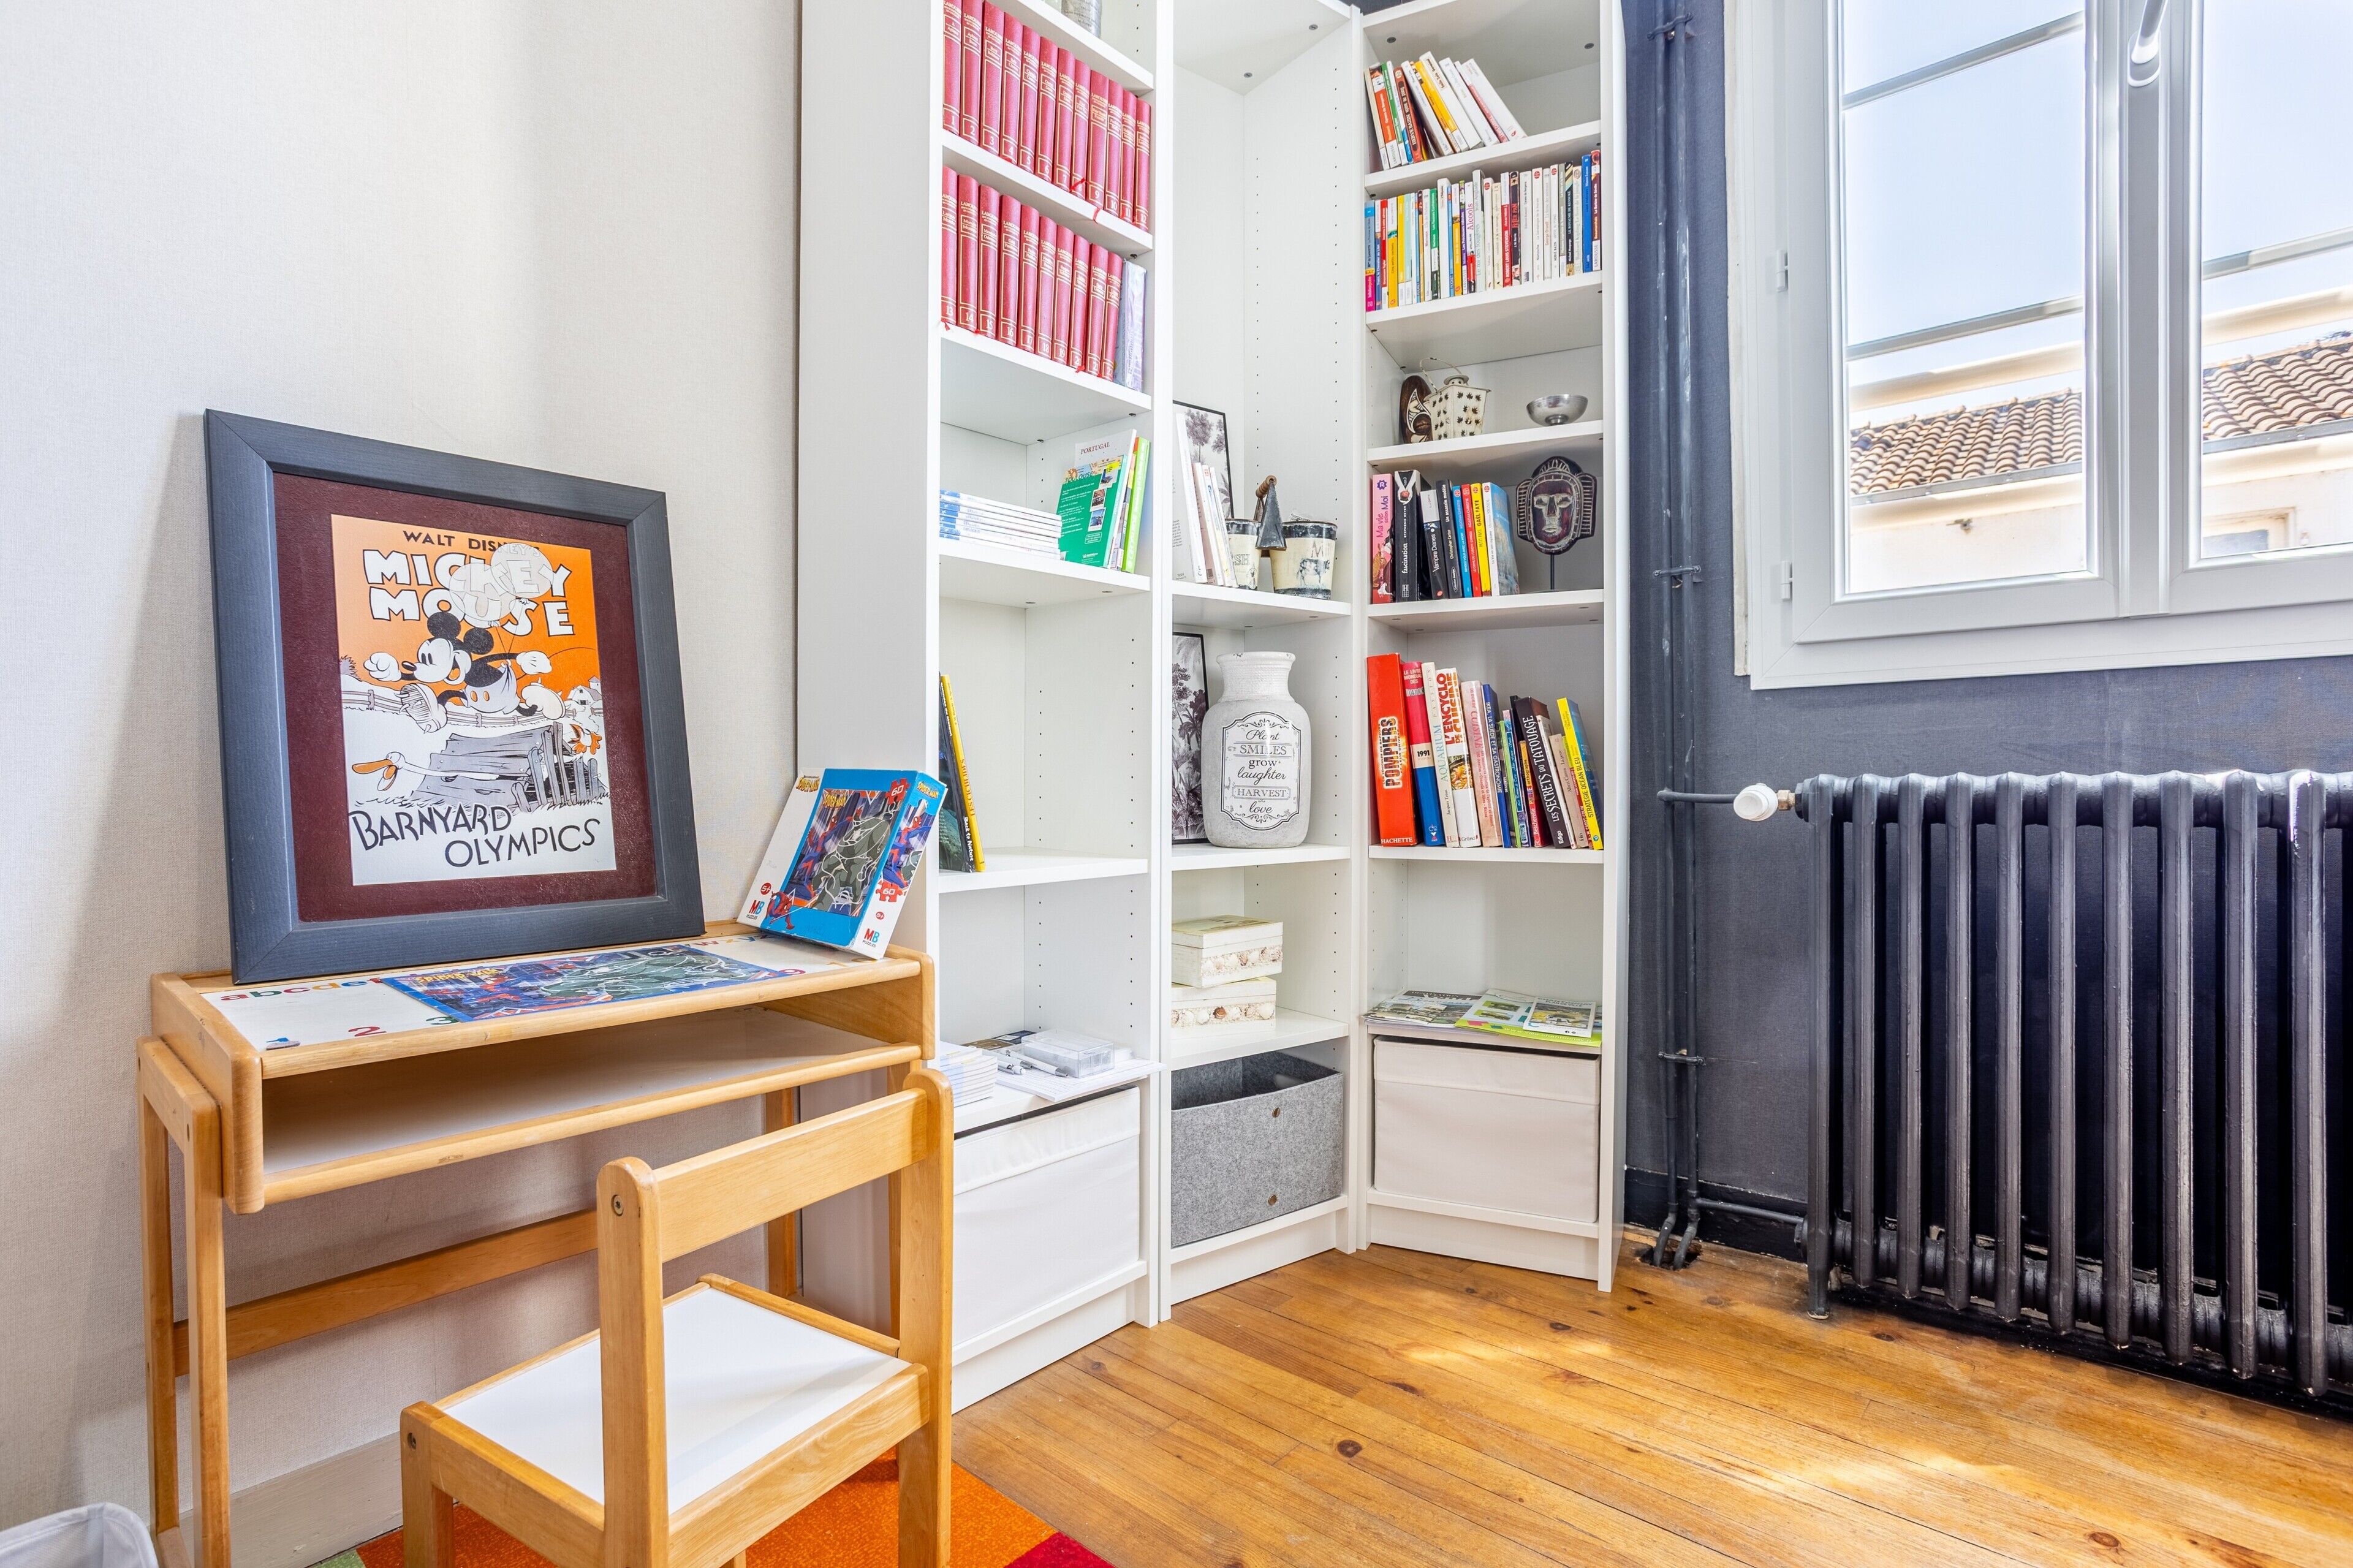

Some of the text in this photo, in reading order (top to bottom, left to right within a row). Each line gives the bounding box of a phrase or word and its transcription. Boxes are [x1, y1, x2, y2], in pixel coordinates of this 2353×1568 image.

[951, 115, 955, 124] 1
[970, 125, 974, 134] 2
[990, 135, 994, 145] 3
[1009, 145, 1014, 155] 4
[1026, 155, 1031, 165] 5
[1044, 165, 1049, 173] 6
[1063, 174, 1066, 184] 7
[1094, 191, 1099, 200] 9
[1110, 200, 1116, 210] 10
[1124, 208, 1131, 217] 11
[1140, 214, 1146, 224] 12
[946, 306, 953, 316] 13
[966, 313, 973, 322] 14
[986, 320, 992, 329] 15
[1007, 327, 1014, 336] 16
[1027, 335, 1033, 344] 17
[1043, 343, 1049, 352] 18
[1059, 349, 1065, 358] 19
[1081, 442, 1110, 455] PORTUGAL
[1376, 525, 1384, 537] Ma
[403, 530, 540, 558] WALT DISNEY'S
[1231, 554, 1249, 565] SH
[1431, 551, 1440, 572] Vampire
[363, 549, 572, 597] MICKEY
[369, 586, 574, 637] MOUSE
[1427, 669, 1438, 717] PASSION
[1436, 673, 1455, 744] L'ENCYCLO
[1446, 673, 1461, 743] DE CUISINE
[1246, 729, 1279, 741] Plant
[1522, 716, 1543, 765] TATOUAGE
[1240, 744, 1287, 756] SMILES
[1381, 718, 1401, 786] POMPIERS
[1433, 724, 1449, 782] AQUARIUM
[1249, 759, 1277, 768] grow
[1238, 767, 1287, 786] laughter
[1493, 756, 1502, 793] GASTRONOMIE
[892, 785, 904, 796] 60
[1539, 773, 1560, 811] SECRETS
[1564, 781, 1572, 792] Albert
[1573, 757, 1594, 818] STRATÉGIE OCÉAN BLEU
[1238, 789, 1286, 797] HARVEST
[1249, 801, 1273, 814] love
[1530, 808, 1539, 835] Bescherelle
[1551, 812, 1559, 821] LES
[349, 803, 512, 850] BARNYARD
[445, 819, 601, 867] OLYMPICS
[749, 900, 765, 914] MB
[864, 928, 880, 943] MB
[426, 1016, 458, 1026] 3
[348, 1026, 386, 1037] 2
